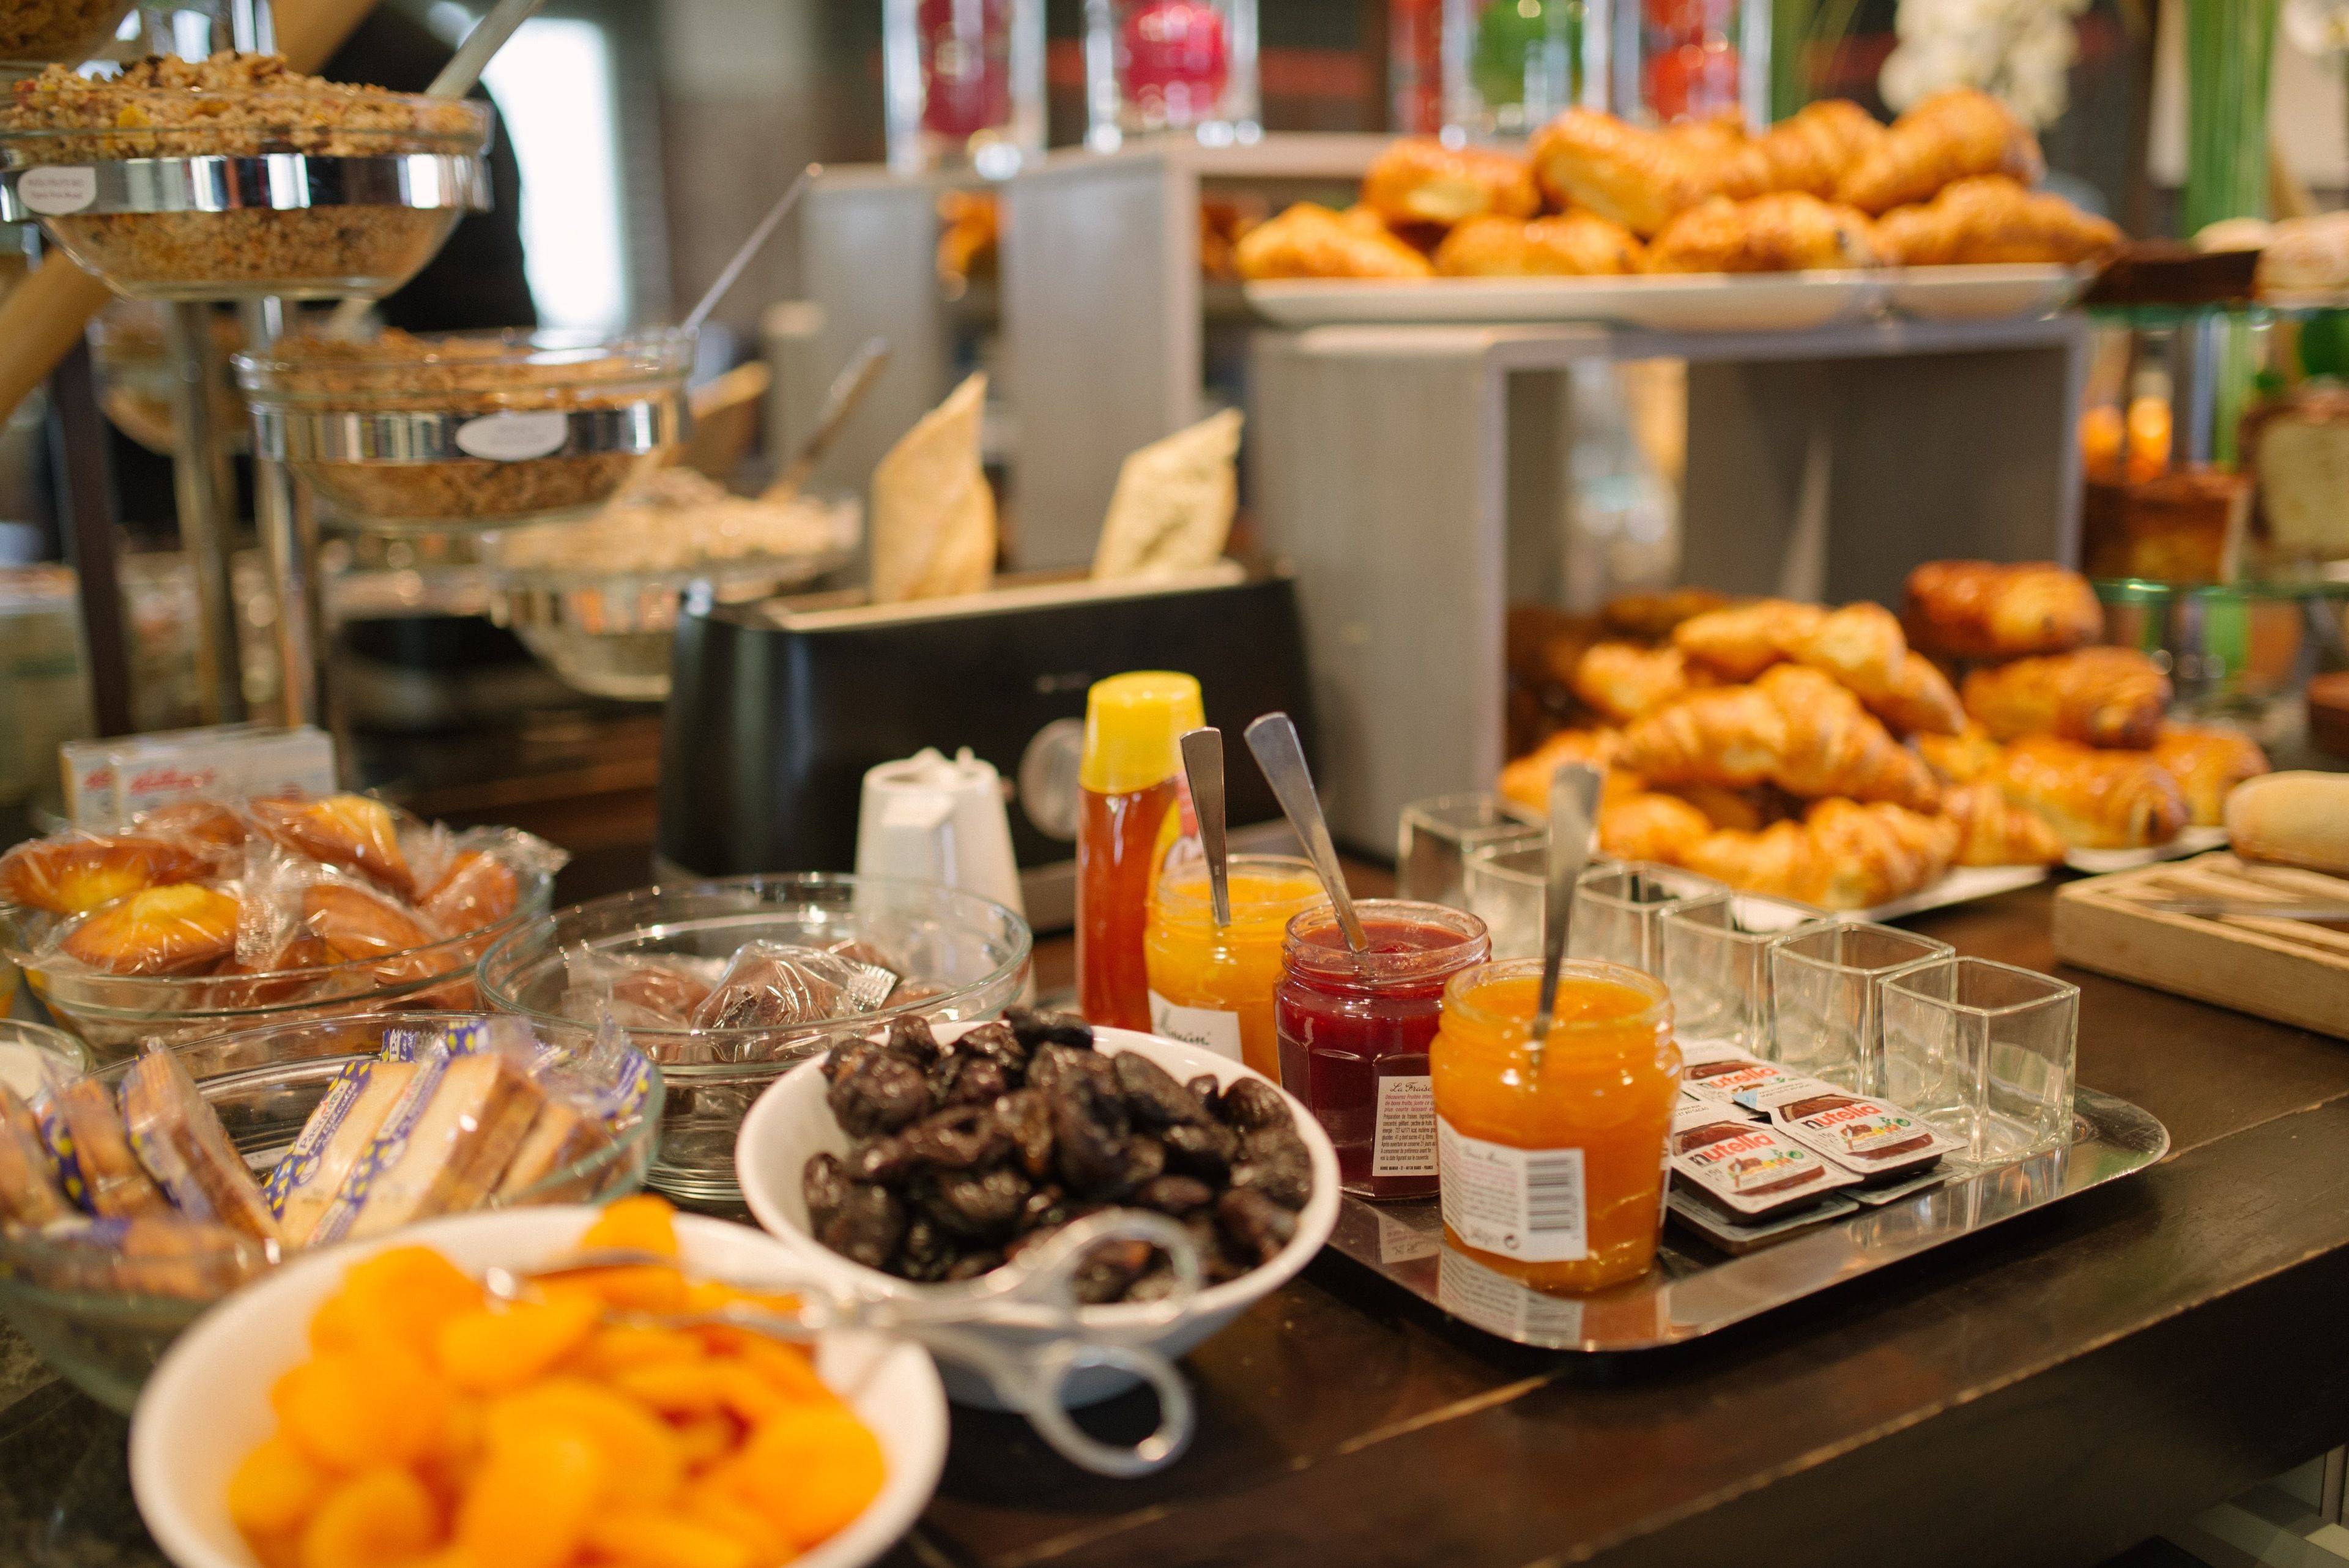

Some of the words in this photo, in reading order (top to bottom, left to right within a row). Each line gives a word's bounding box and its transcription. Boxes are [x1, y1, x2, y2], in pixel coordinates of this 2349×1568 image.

[1390, 1082, 1402, 1092] La
[1405, 1082, 1432, 1092] Fraise
[1697, 1067, 1779, 1088] nutella
[299, 1085, 344, 1150] Pasquier
[1800, 1104, 1883, 1131] nutella
[308, 1136, 323, 1156] La
[1688, 1133, 1776, 1167] nutella
